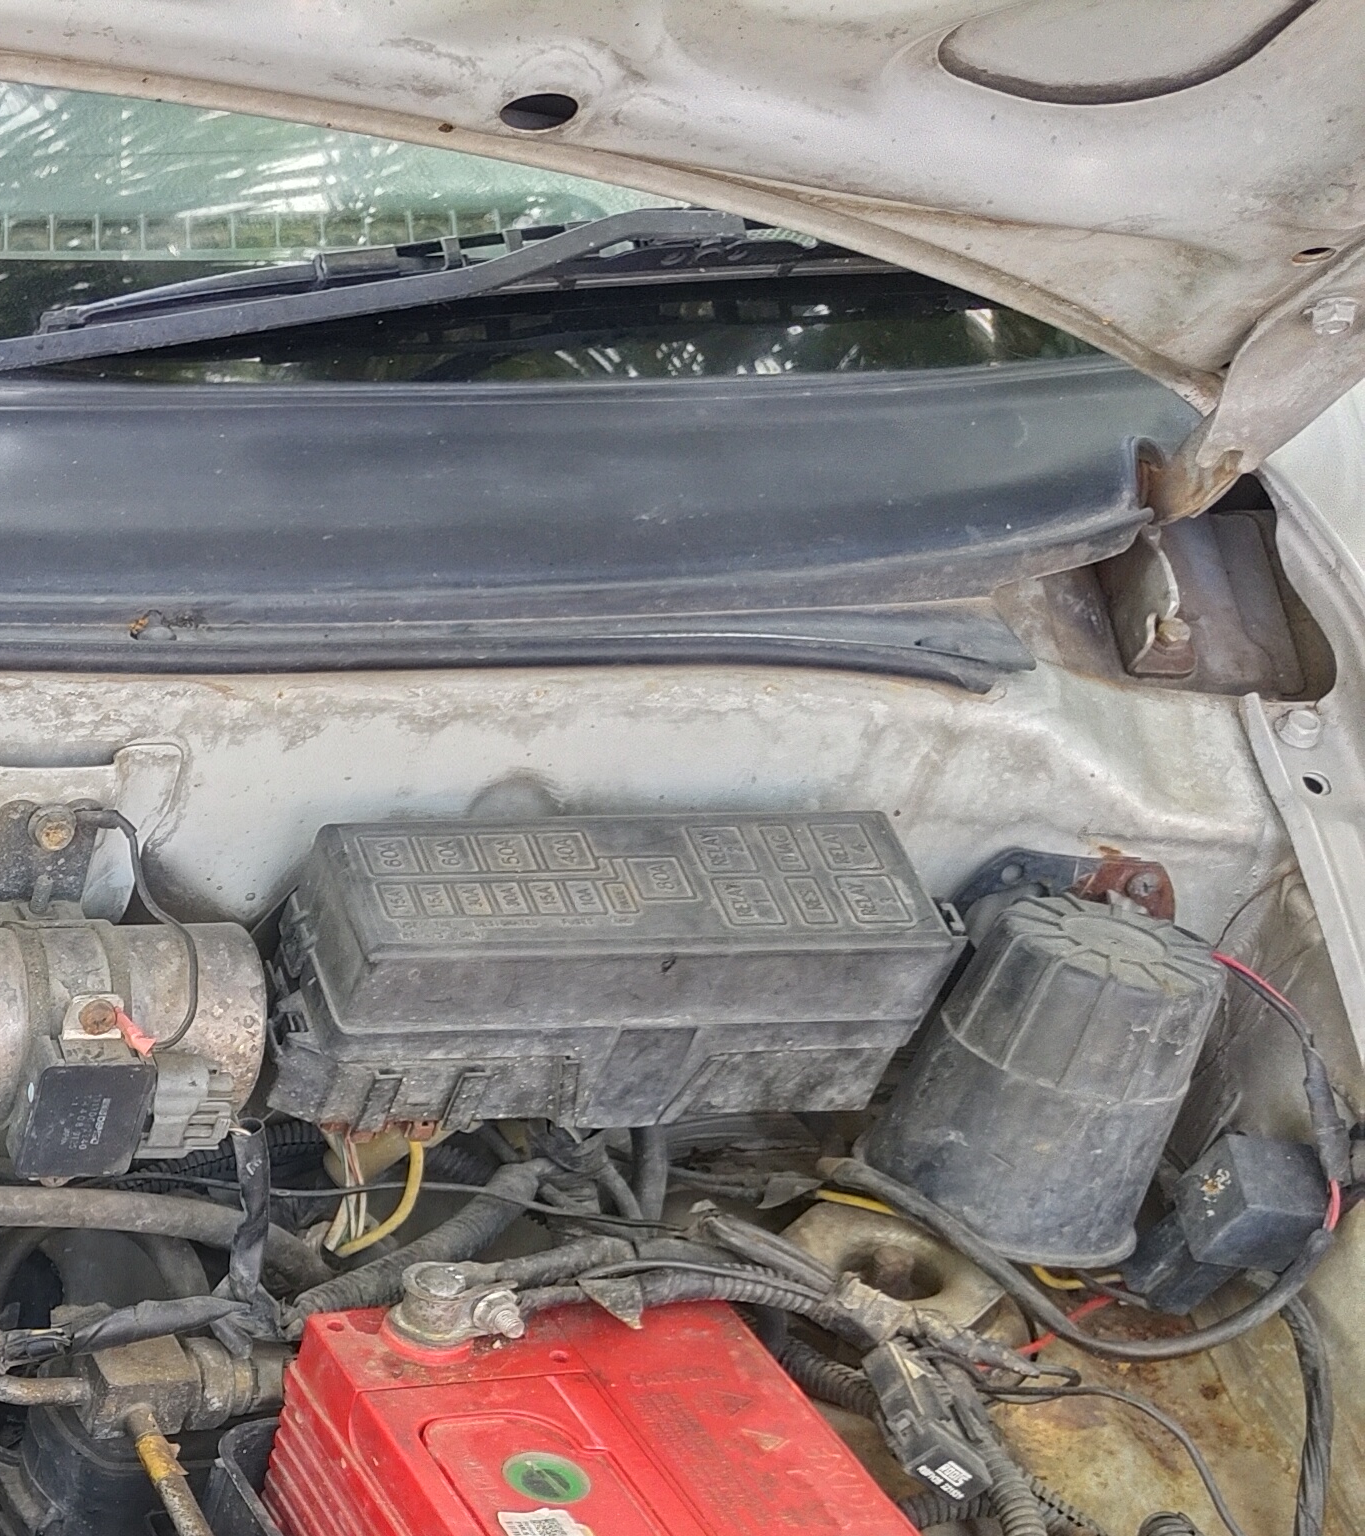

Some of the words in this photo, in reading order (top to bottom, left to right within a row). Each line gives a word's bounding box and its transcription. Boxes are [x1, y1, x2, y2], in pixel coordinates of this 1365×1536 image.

[379, 840, 403, 868] 60A
[437, 839, 461, 867] 60A
[497, 838, 521, 866] 50A
[556, 837, 577, 865] 40A
[698, 831, 730, 866] RELAY
[771, 832, 795, 864] DIAG
[821, 831, 852, 864] RELAY
[648, 862, 676, 891] 80A
[724, 881, 756, 918] RELAY
[847, 881, 879, 917] RELAY
